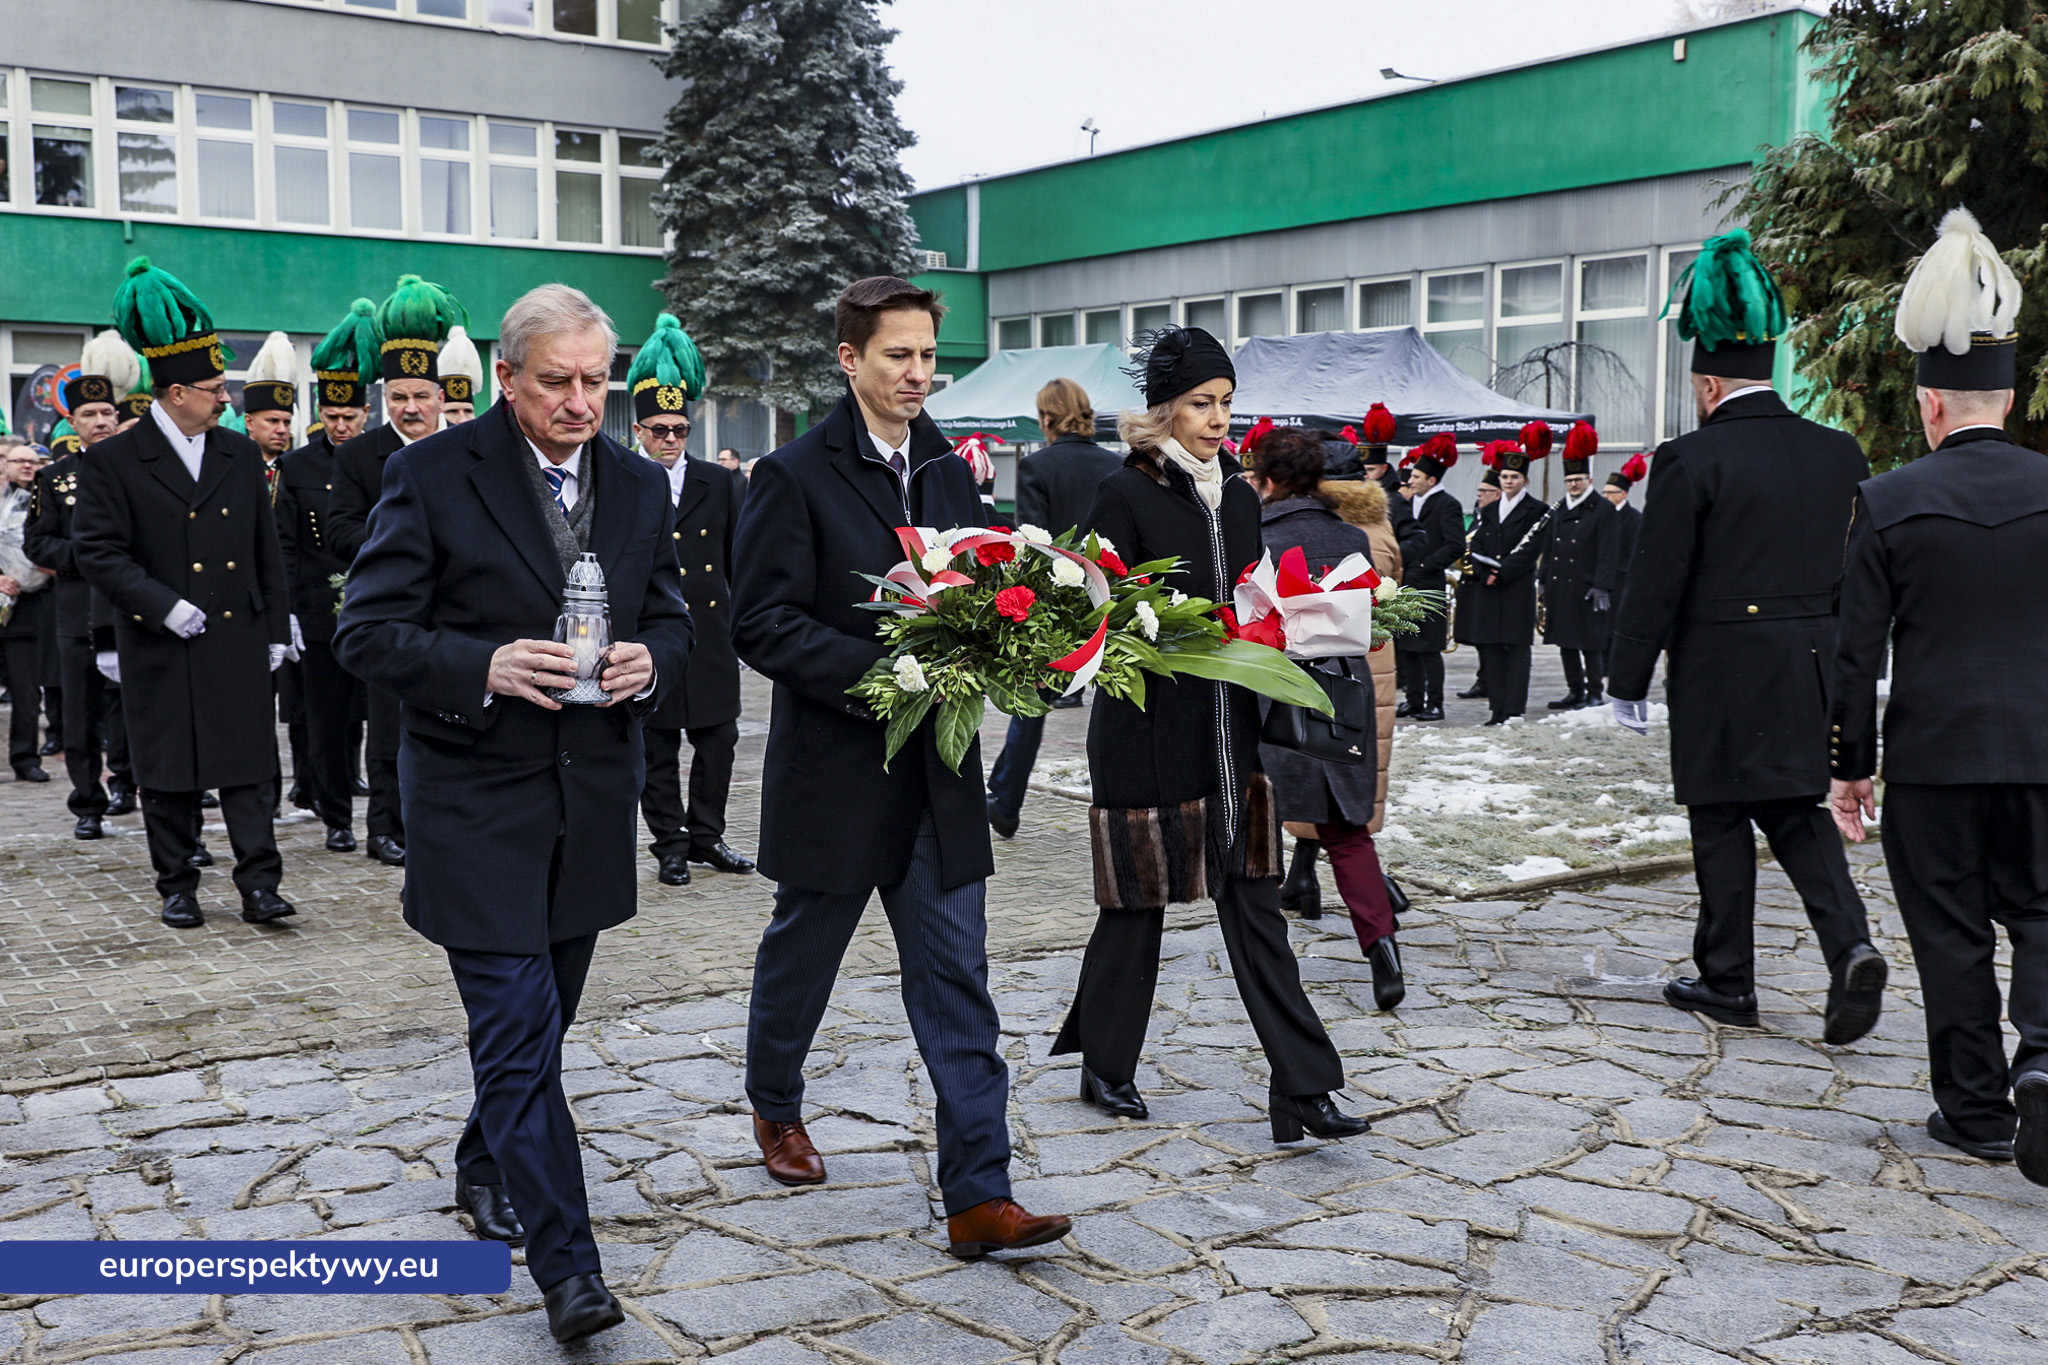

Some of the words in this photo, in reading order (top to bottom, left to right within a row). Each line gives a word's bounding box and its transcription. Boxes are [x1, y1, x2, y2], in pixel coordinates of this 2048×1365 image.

[1230, 417, 1251, 425] nictwa
[1289, 417, 1303, 426] S.A.
[1417, 423, 1455, 433] Centralna
[1456, 422, 1479, 433] Stacja
